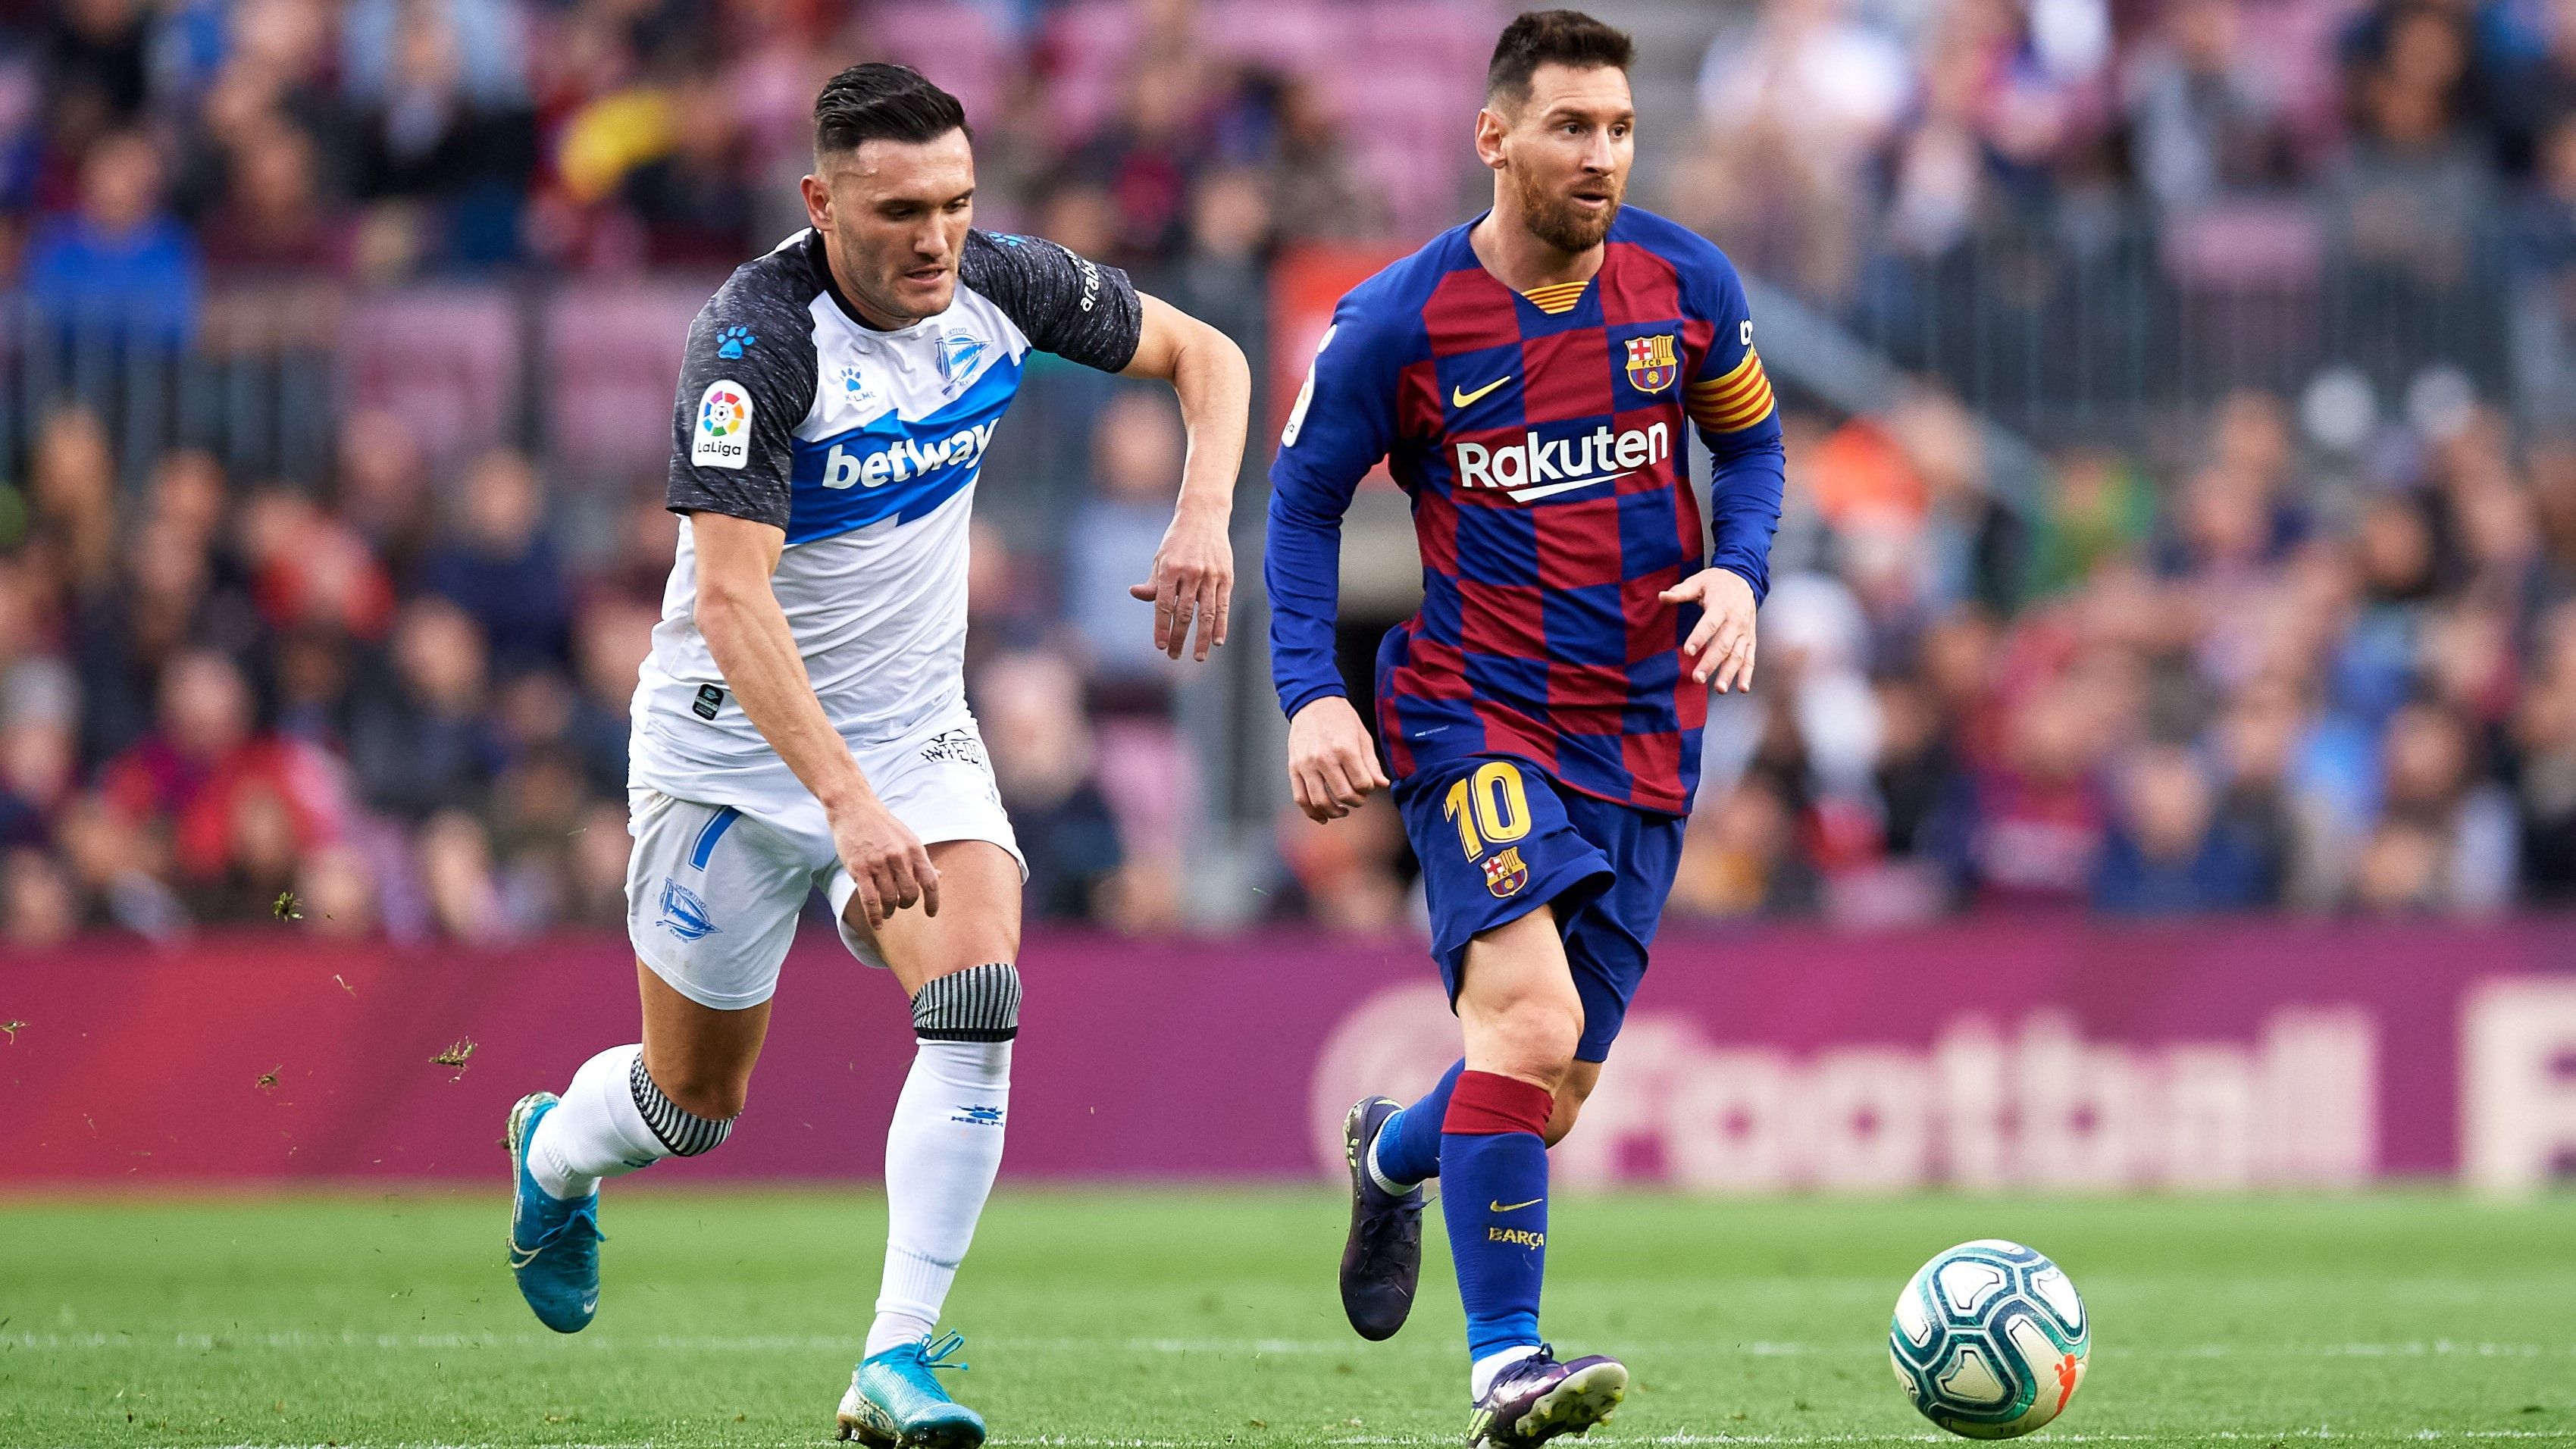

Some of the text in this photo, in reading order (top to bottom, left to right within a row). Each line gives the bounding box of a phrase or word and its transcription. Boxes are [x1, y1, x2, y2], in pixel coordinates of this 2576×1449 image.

[1081, 258, 1100, 312] arab
[697, 440, 742, 457] LaLiga
[822, 417, 1000, 490] betway
[1455, 421, 1669, 489] Rakuten
[1443, 760, 1532, 864] 10
[1488, 1227, 1545, 1250] BARÇA
